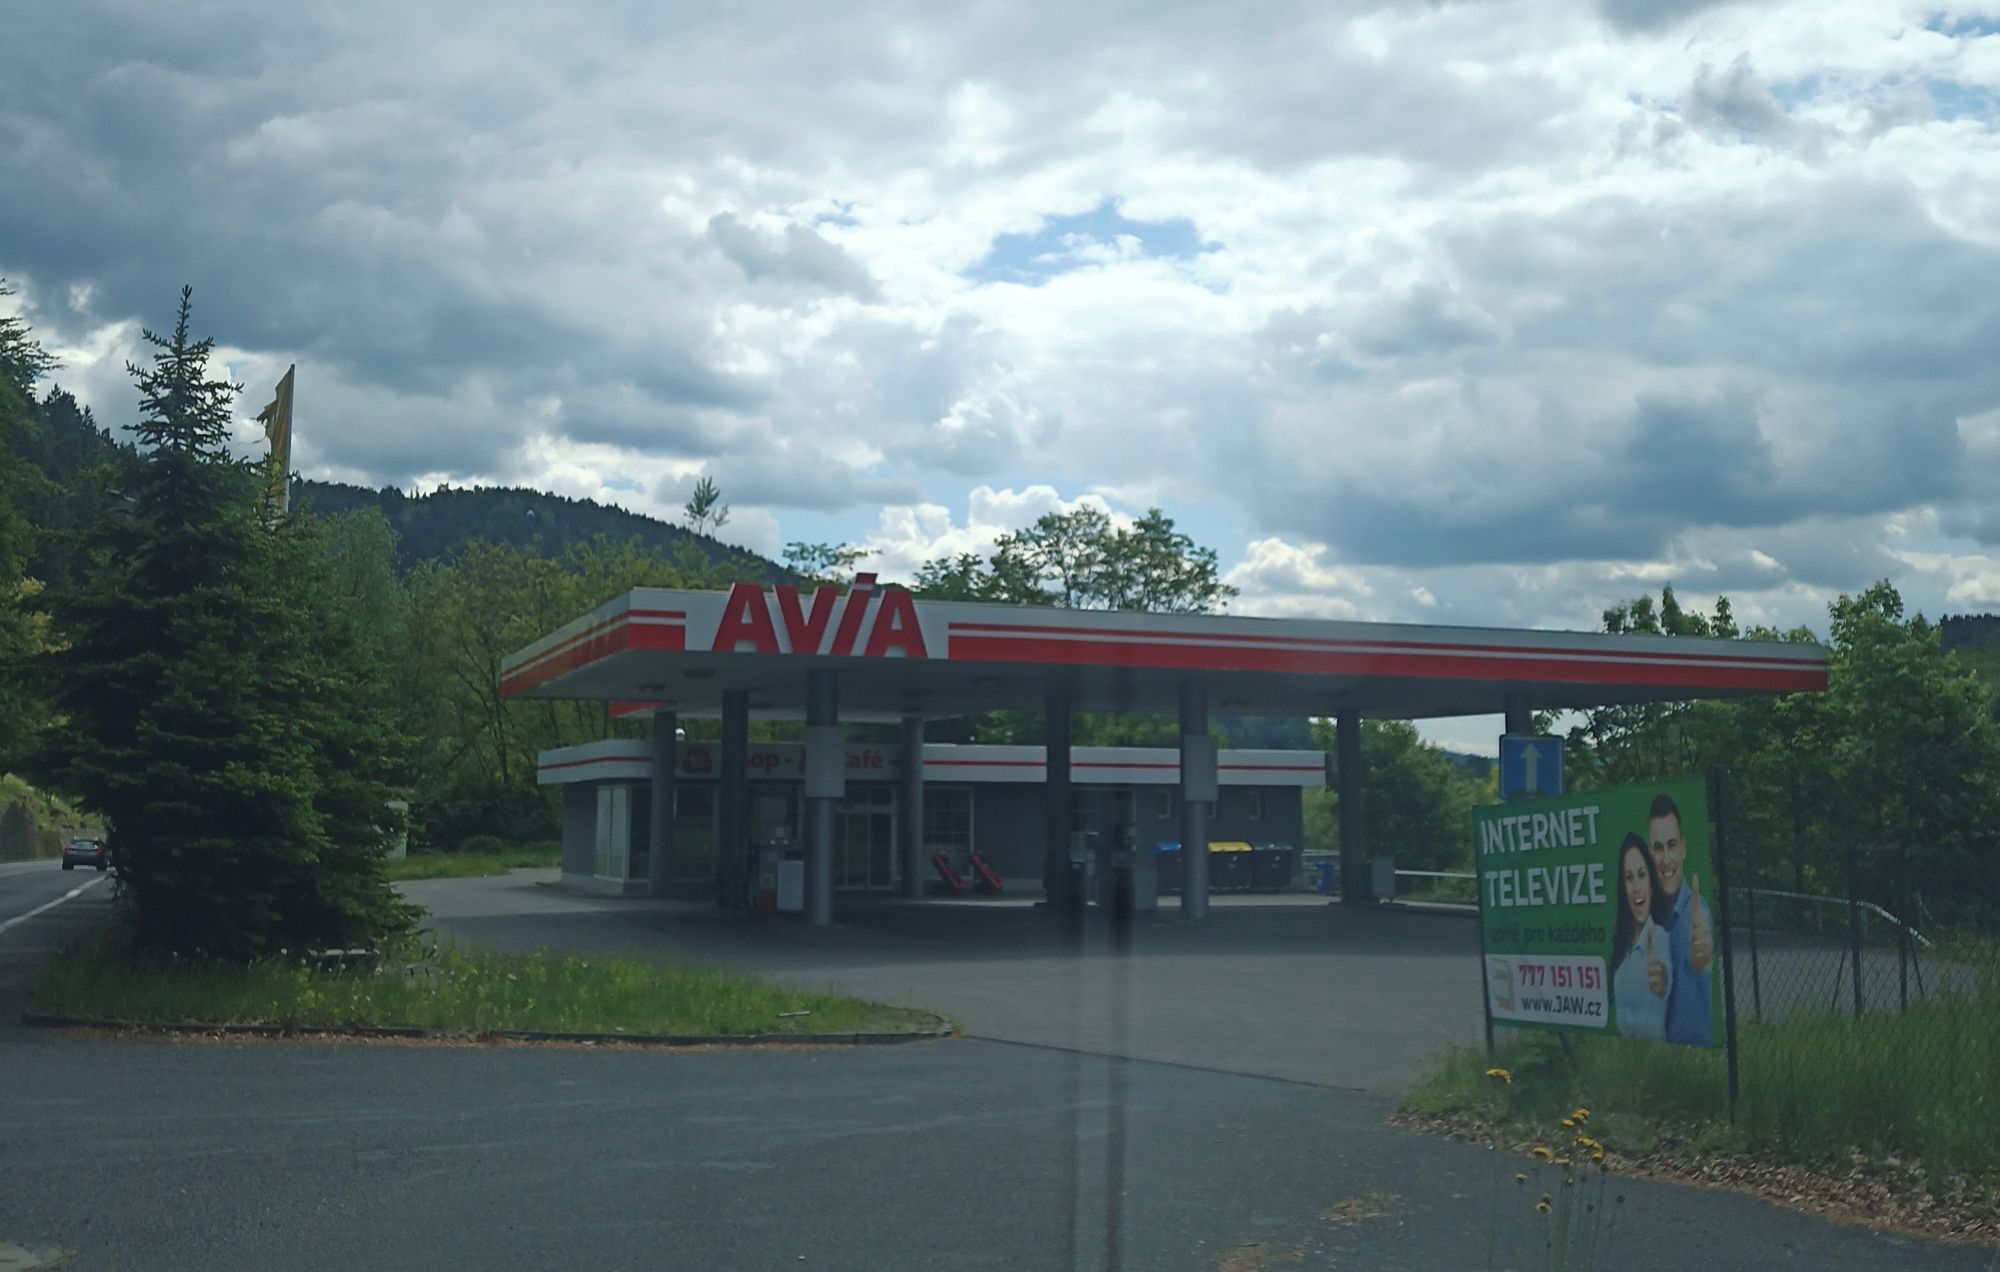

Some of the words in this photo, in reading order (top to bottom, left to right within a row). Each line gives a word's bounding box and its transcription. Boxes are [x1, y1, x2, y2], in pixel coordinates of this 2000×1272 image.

[847, 750, 883, 769] afé
[1481, 805, 1600, 855] INTERNET
[1485, 863, 1607, 908] TELEVIZE
[1524, 927, 1545, 946] pro
[1518, 964, 1545, 987] 777
[1550, 965, 1572, 988] 151
[1577, 966, 1601, 990] 151
